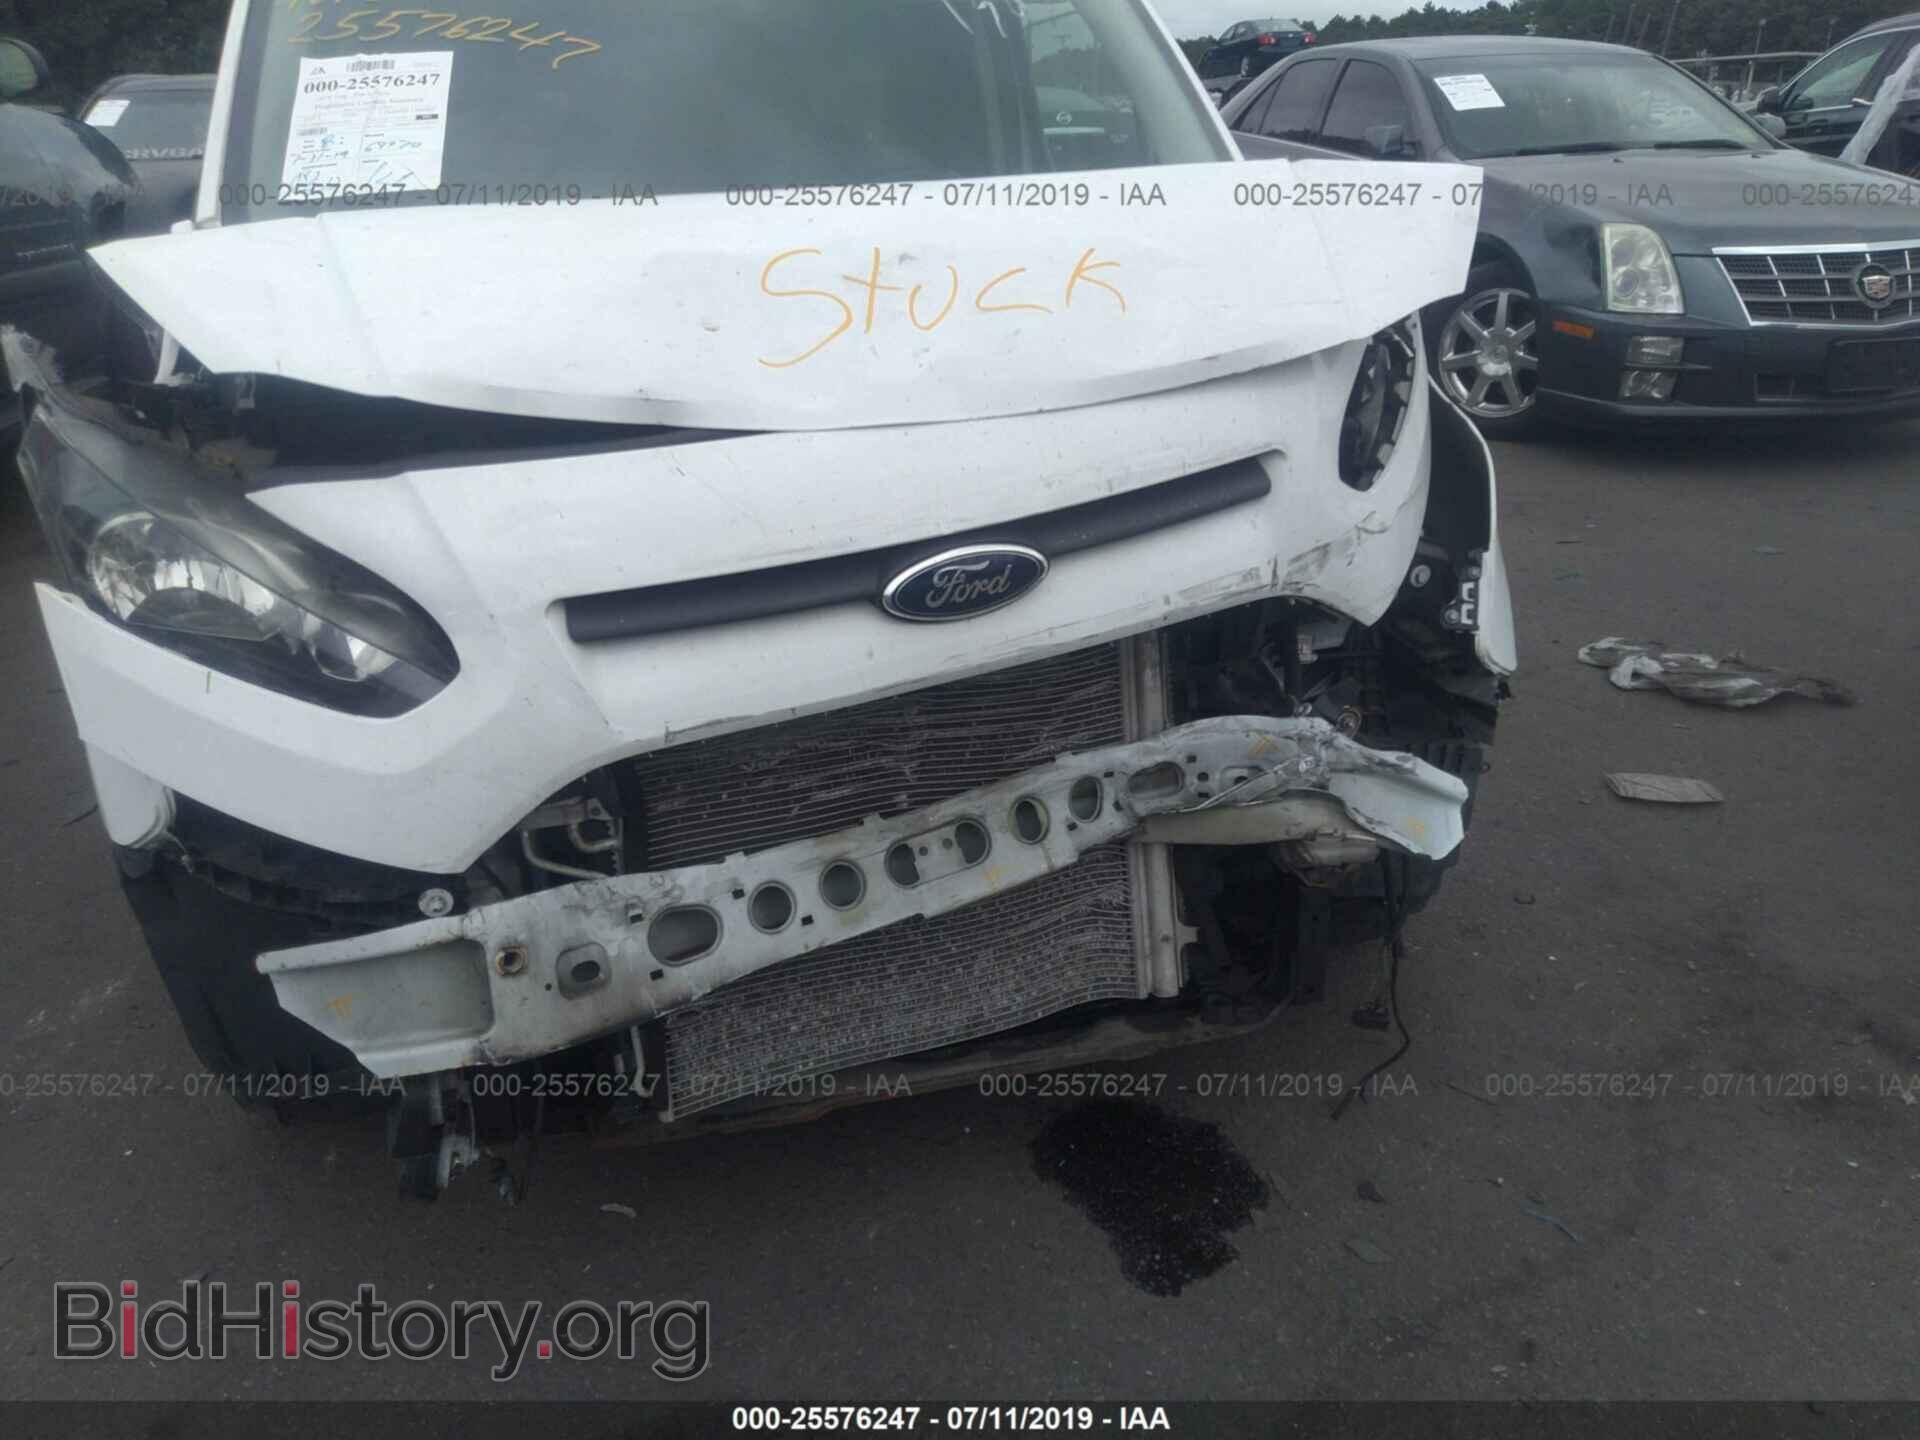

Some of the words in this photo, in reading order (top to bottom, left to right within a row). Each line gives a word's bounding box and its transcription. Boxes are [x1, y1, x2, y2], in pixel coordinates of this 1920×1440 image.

[287, 11, 602, 70] 25576247
[303, 73, 441, 94] 000-25576247
[925, 560, 1013, 608] Ford
